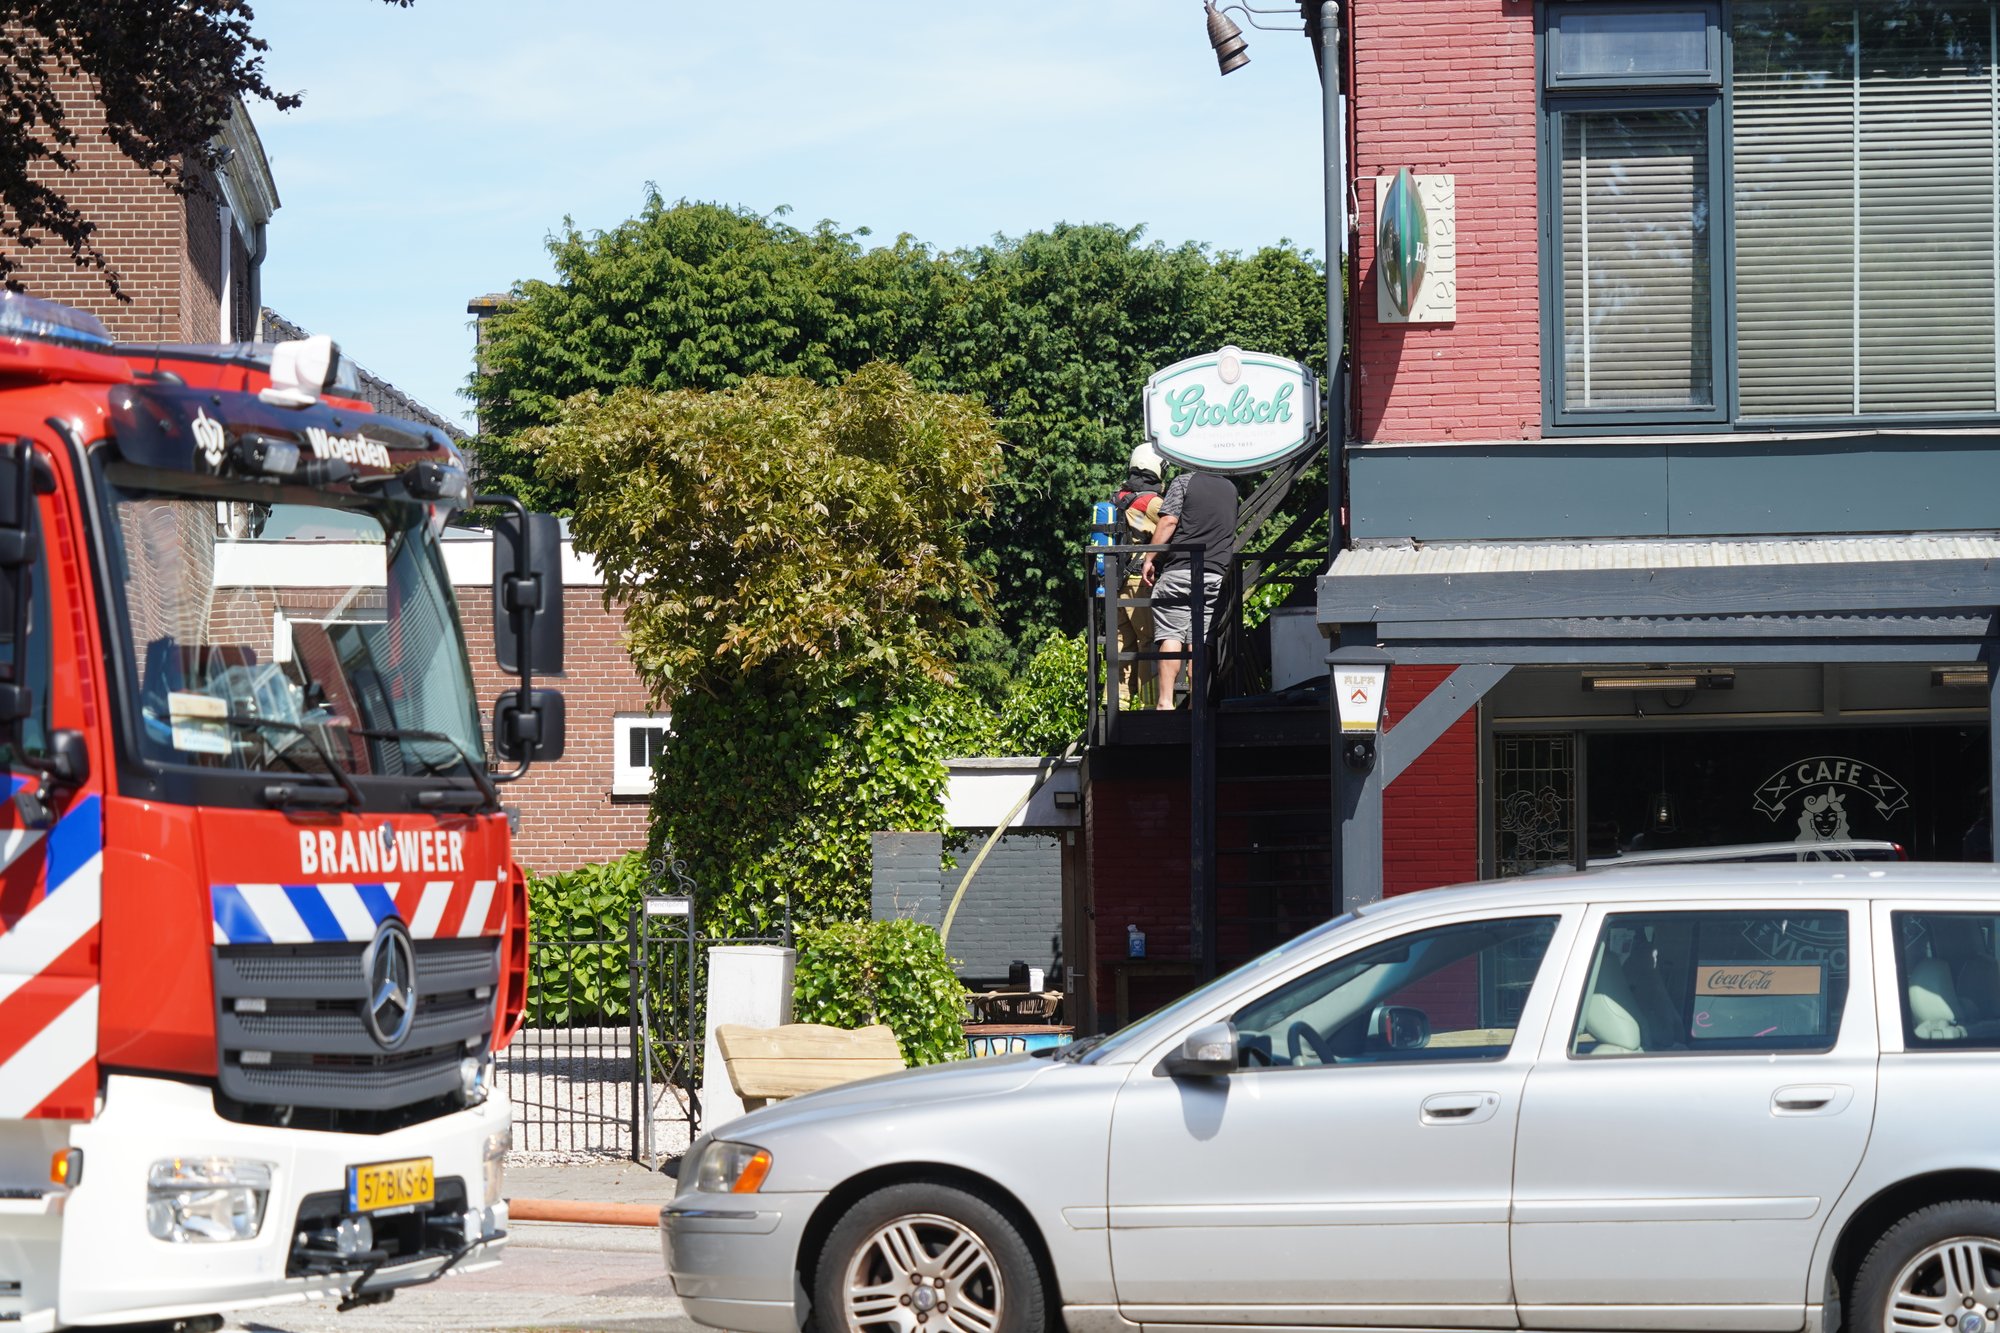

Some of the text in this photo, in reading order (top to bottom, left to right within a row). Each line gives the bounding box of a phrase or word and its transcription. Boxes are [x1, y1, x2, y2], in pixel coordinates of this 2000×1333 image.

[1165, 382, 1294, 436] Grolsch
[306, 427, 391, 468] Woerden
[1344, 675, 1376, 685] ALFA
[1798, 761, 1862, 784] CAFE
[299, 830, 464, 874] BRANDWEER
[364, 1166, 429, 1203] 57-BKS-6
